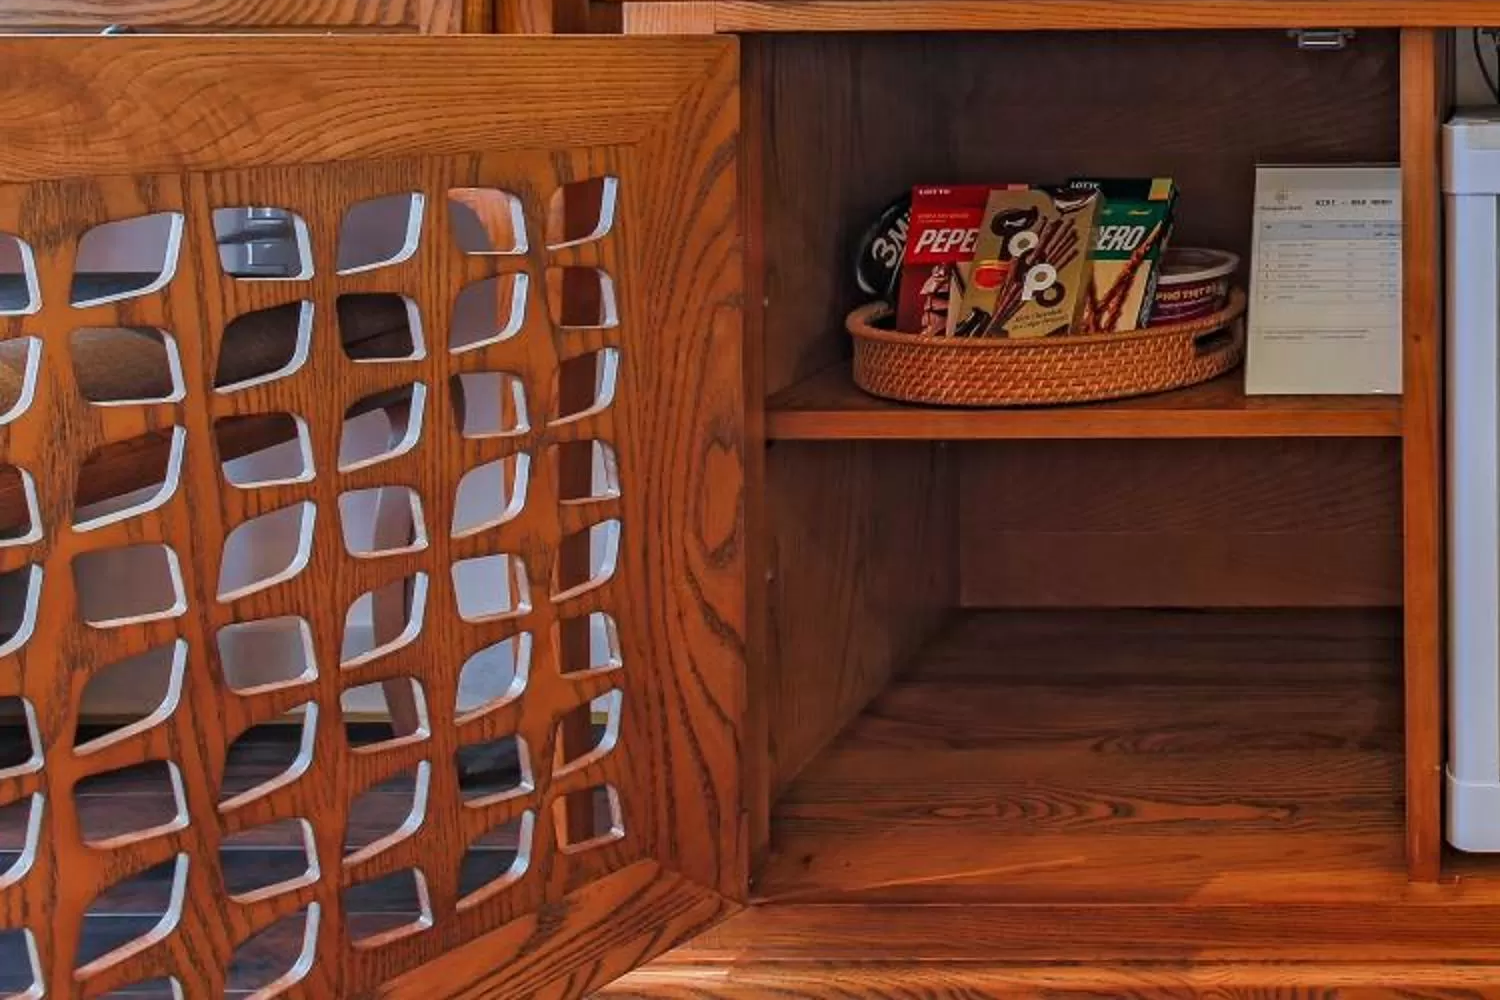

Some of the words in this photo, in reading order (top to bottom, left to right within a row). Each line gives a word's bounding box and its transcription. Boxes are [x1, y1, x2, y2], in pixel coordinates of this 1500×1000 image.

[913, 228, 980, 255] PEPE
[1096, 225, 1147, 252] ERO
[871, 237, 898, 268] 3
